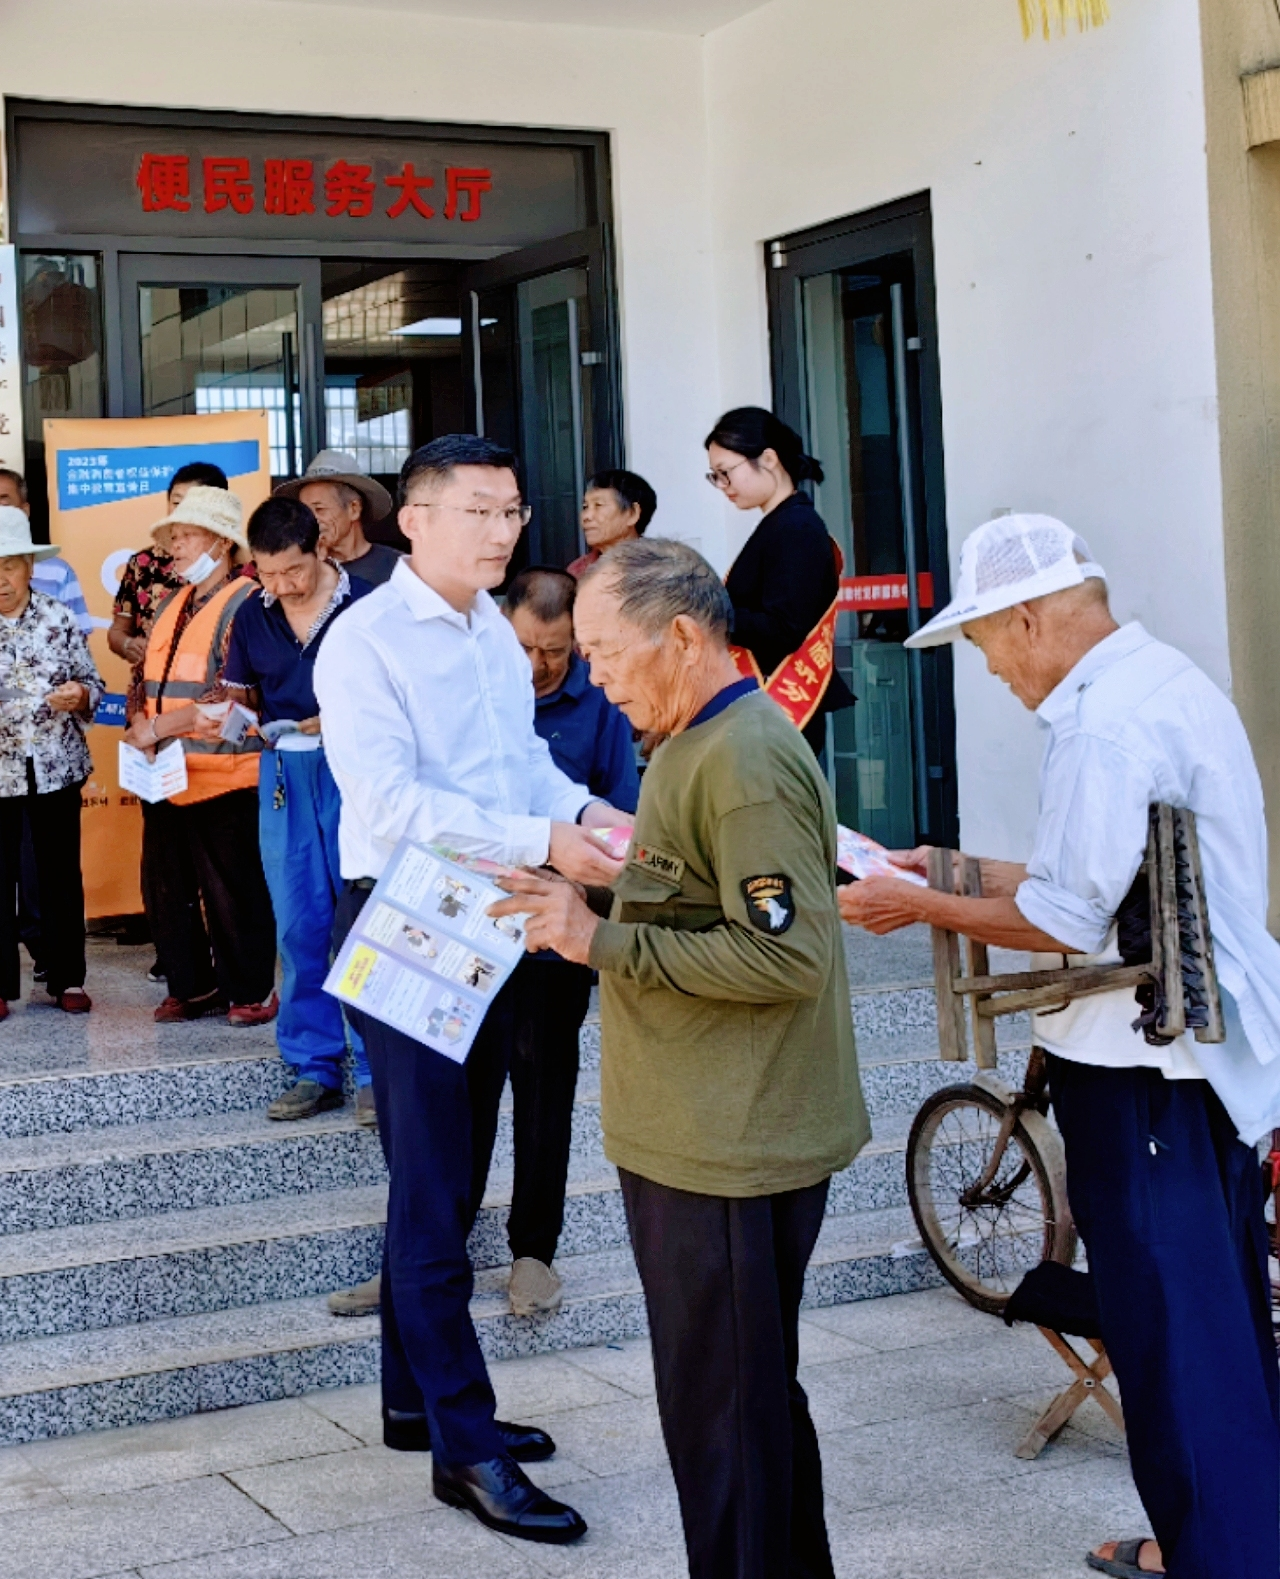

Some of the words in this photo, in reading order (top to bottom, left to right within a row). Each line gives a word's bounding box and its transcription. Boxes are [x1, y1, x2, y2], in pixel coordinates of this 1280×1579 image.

[136, 153, 493, 222] 便民服务大厅
